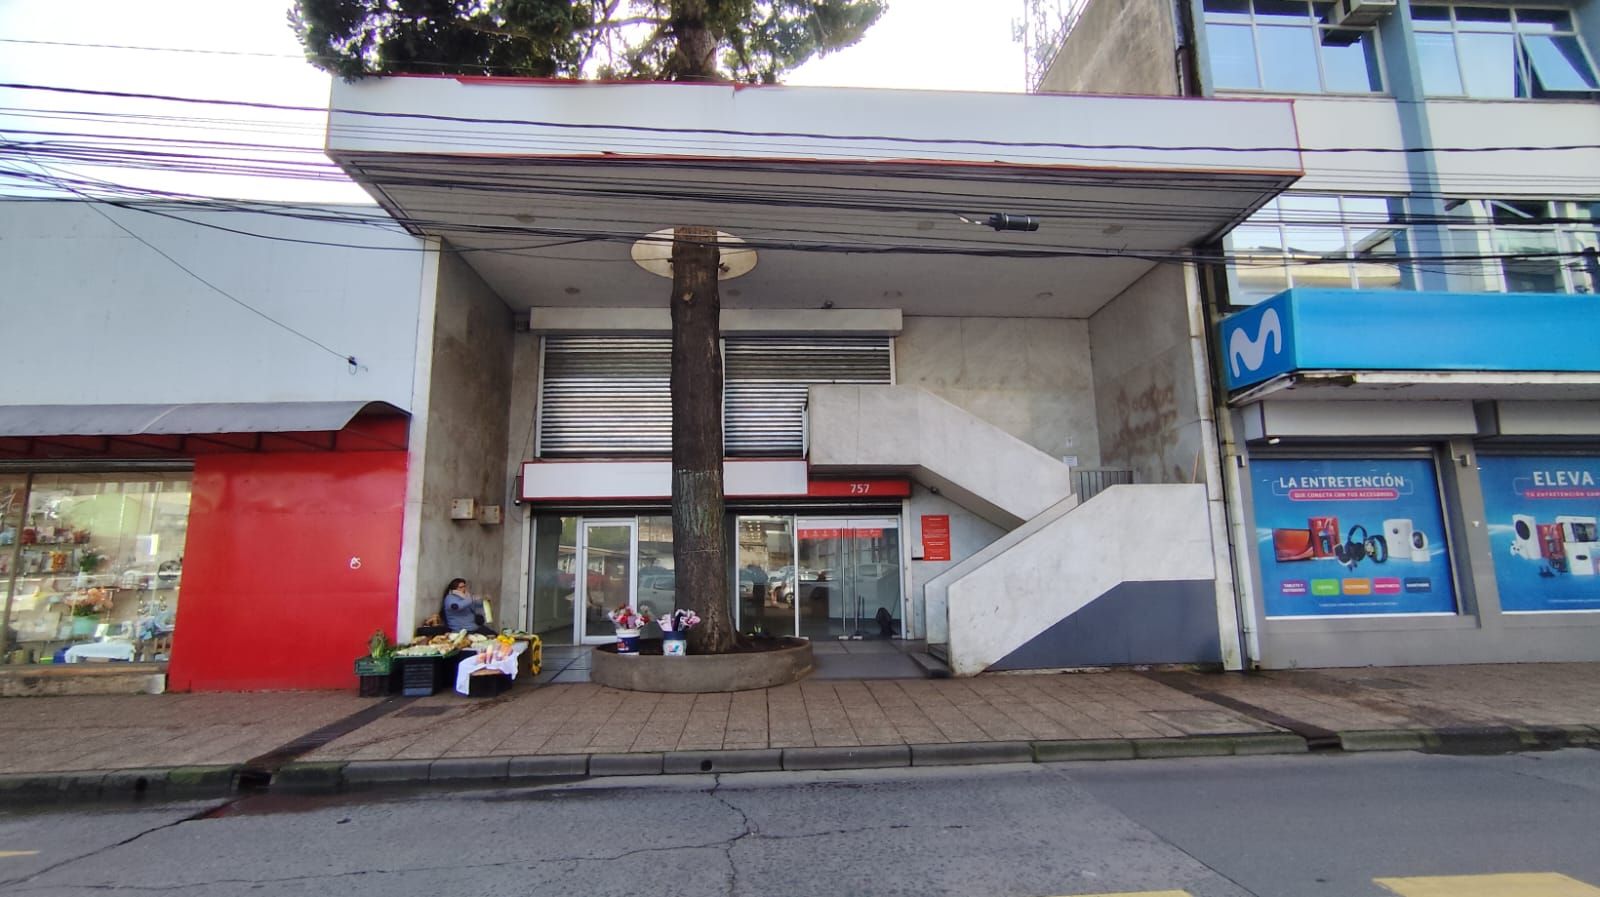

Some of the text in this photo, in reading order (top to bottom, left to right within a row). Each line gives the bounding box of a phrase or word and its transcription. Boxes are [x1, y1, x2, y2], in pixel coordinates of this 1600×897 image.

[1279, 473, 1404, 488] LA ENTRETENCIÓN
[1533, 471, 1594, 486] ELEVA
[850, 483, 870, 494] 757
